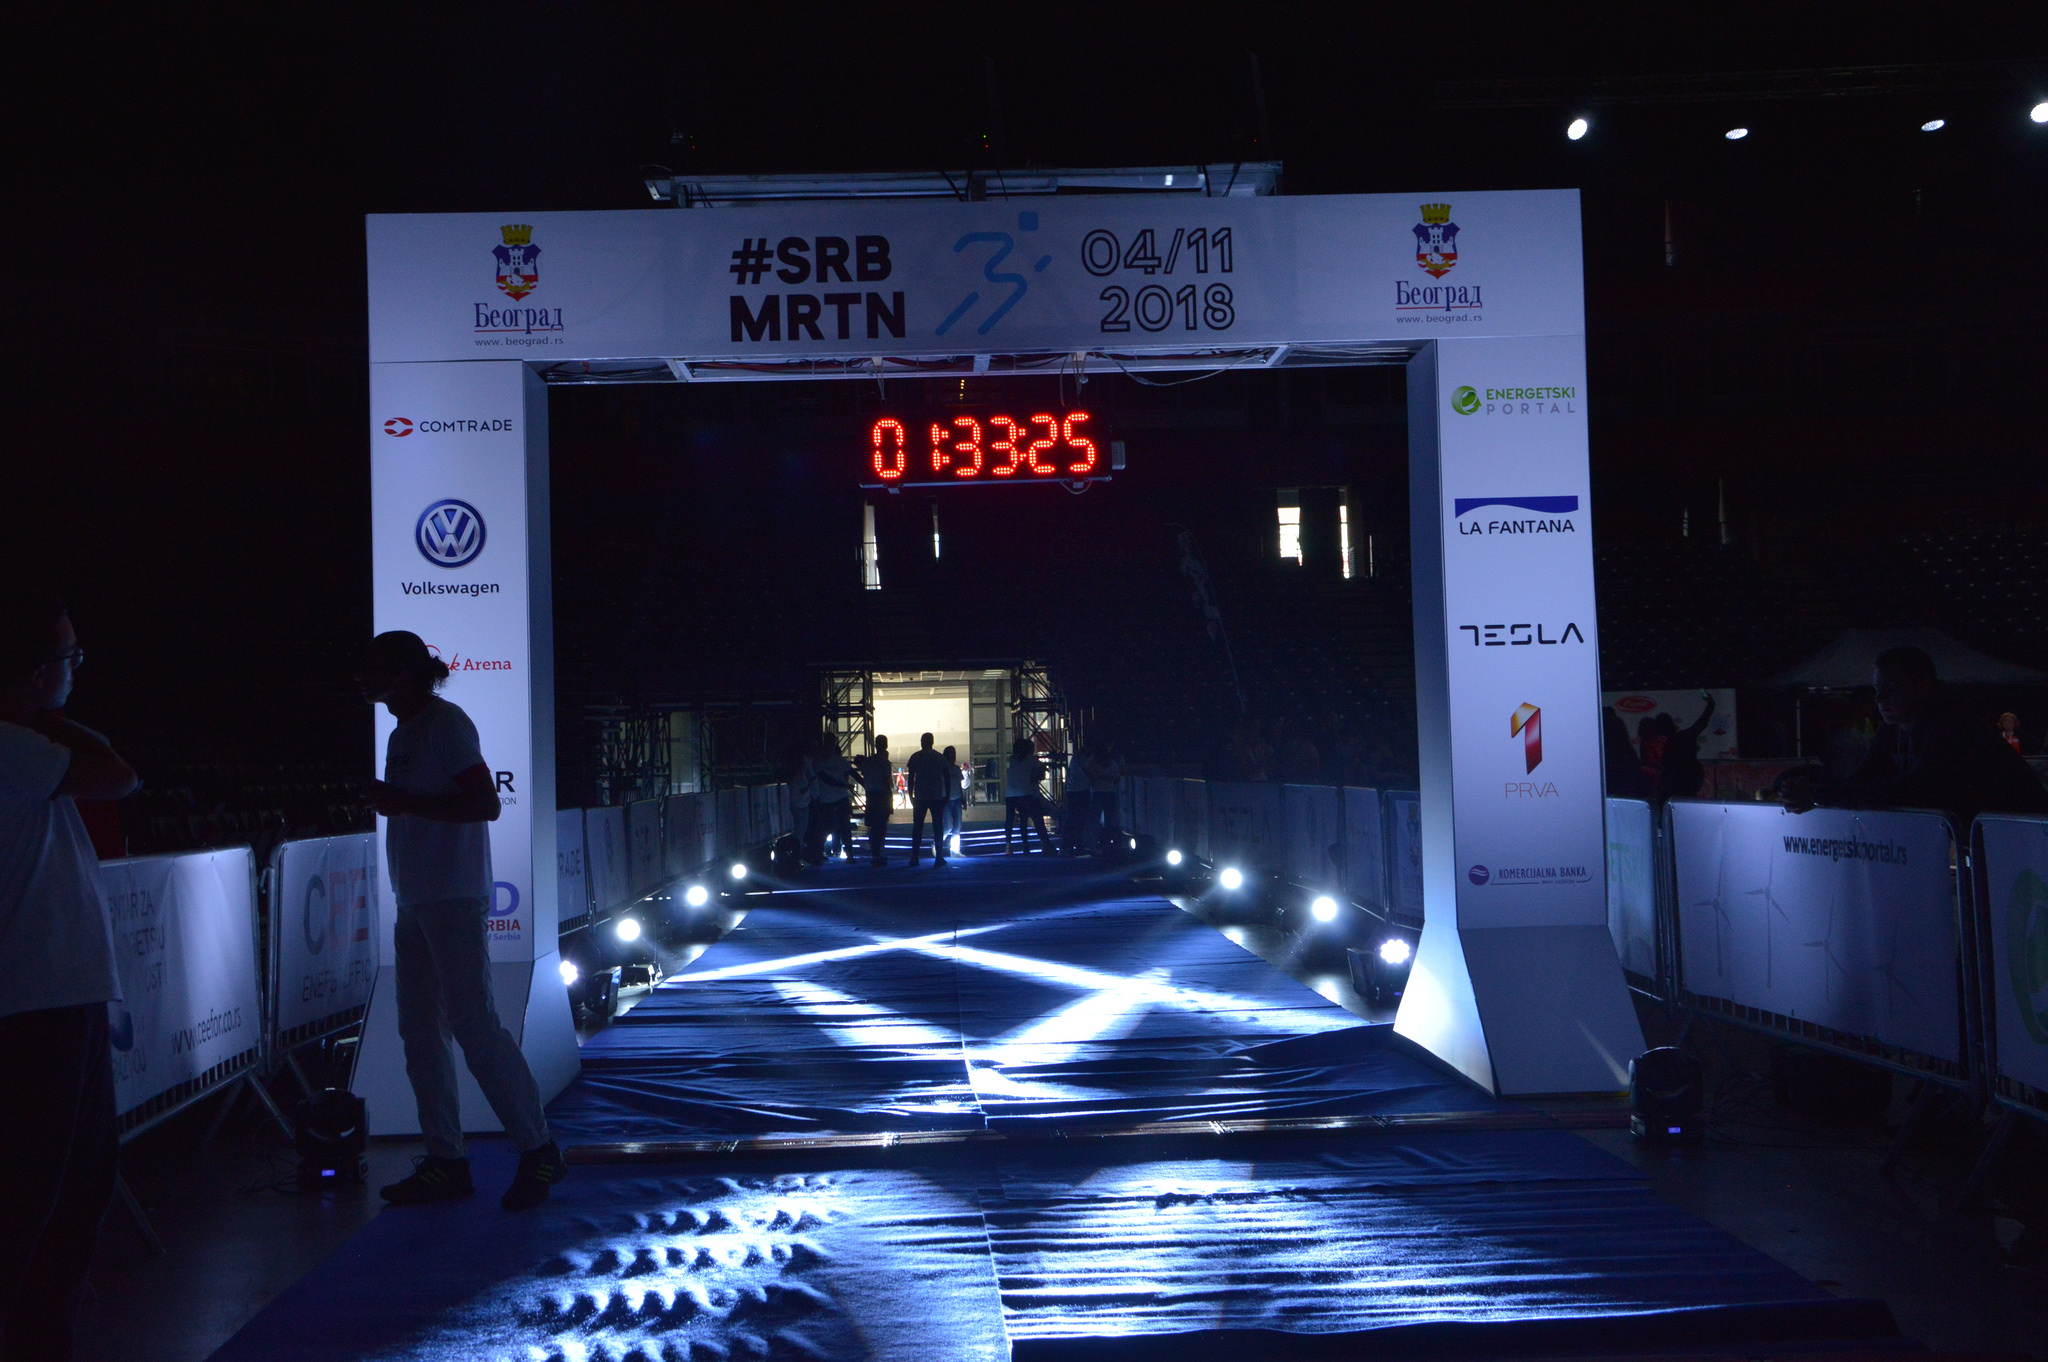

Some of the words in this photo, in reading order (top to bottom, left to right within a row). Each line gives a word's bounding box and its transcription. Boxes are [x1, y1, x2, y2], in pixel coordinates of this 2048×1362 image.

[730, 235, 892, 284] #SRB
[1080, 227, 1234, 276] 04/11
[1395, 280, 1483, 311] Београд
[1100, 283, 1235, 332] 2018
[474, 302, 564, 334] Београд
[730, 291, 906, 342] MRTN
[1486, 387, 1576, 401] ENERGETSKI
[1486, 402, 1576, 416] PORTAL
[419, 419, 513, 433] COMTRADE
[1459, 521, 1483, 535] LA
[1488, 519, 1576, 534] FANTANA
[401, 582, 500, 597] Volkswagen
[1459, 622, 1584, 647] TESLA
[462, 658, 512, 671] Arena
[1505, 782, 1560, 799] PRVA
[1498, 867, 1557, 880] KOMERCIJALNA
[1560, 866, 1587, 878] BANKA
